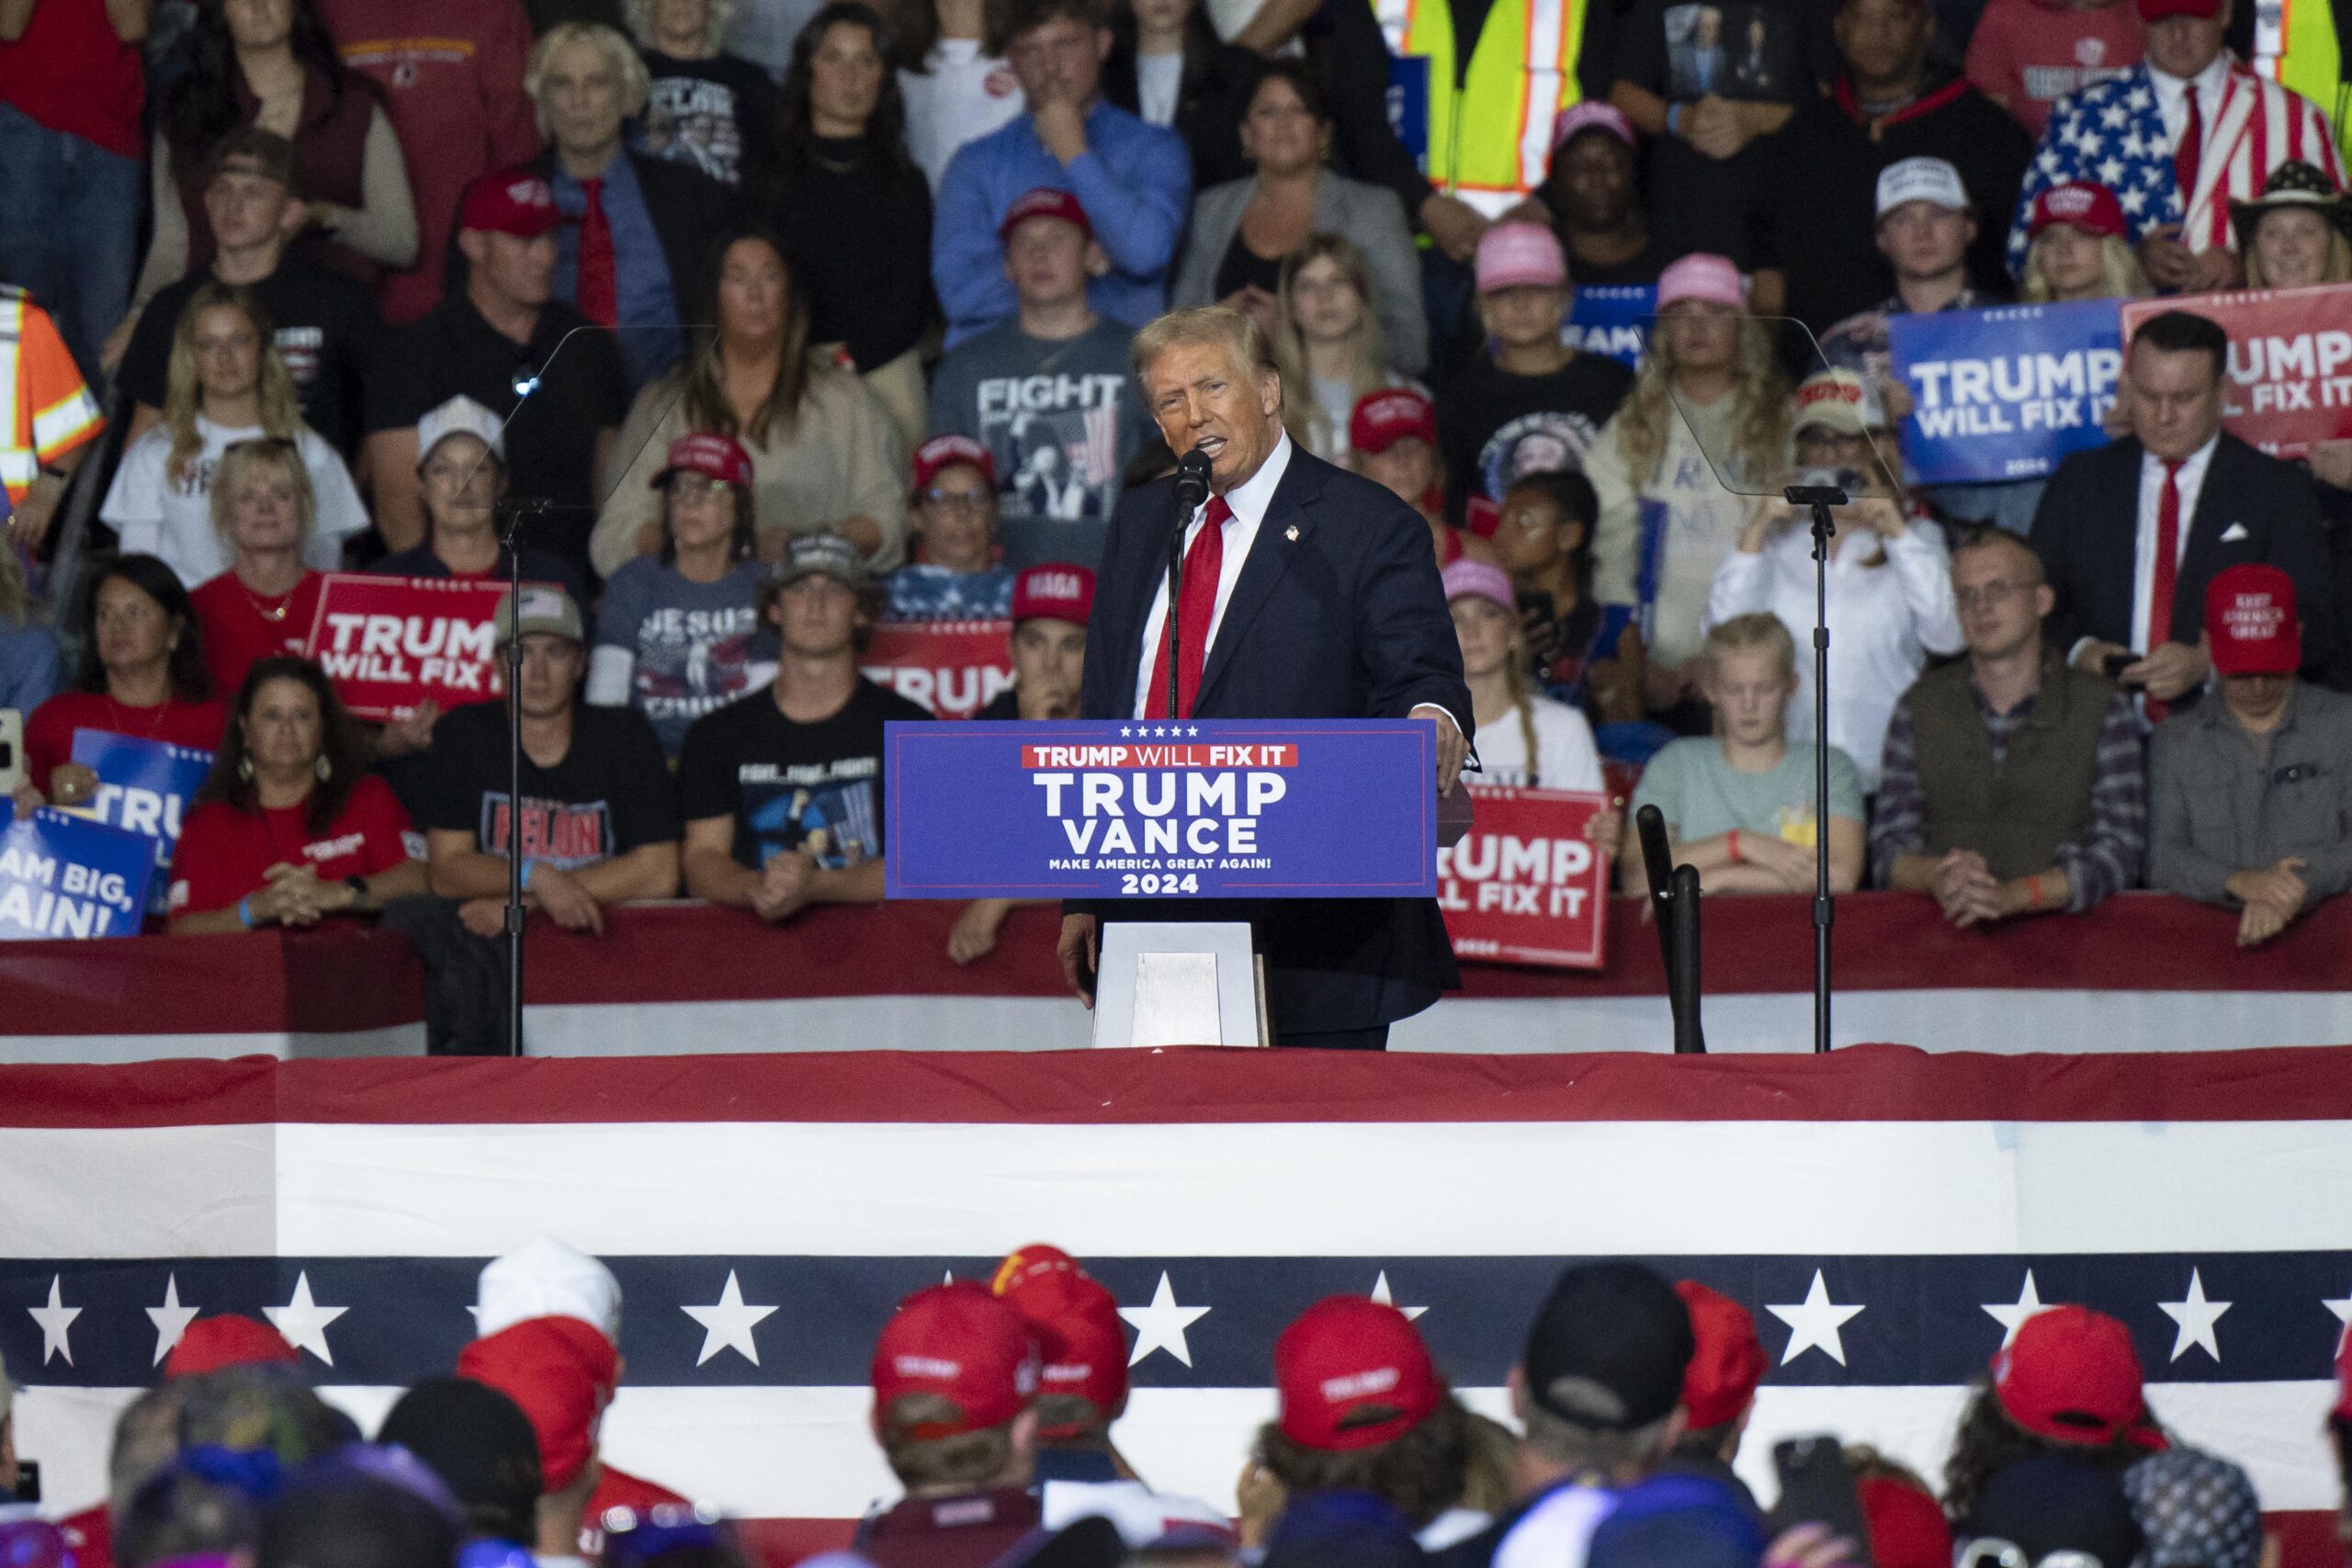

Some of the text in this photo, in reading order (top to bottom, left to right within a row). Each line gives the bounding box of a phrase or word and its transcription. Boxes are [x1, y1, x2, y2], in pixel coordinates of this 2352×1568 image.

[978, 375, 1125, 411] FIGHT
[1910, 349, 2122, 409] TRUMP
[2253, 379, 2312, 413] FIX
[1916, 404, 2013, 439] WILL
[2021, 399, 2082, 431] FIX
[326, 612, 495, 662] TRUM
[321, 649, 413, 683] WILL
[419, 656, 481, 692] FIX
[1034, 746, 1286, 766] TRUMP WILL FIX IT
[1034, 773, 1286, 817] TRUMP
[1062, 818, 1257, 854] VANCE
[1049, 859, 1272, 870] MAKE AMERICA GREAT AGAIN!
[62, 863, 133, 912] BIG,
[1121, 874, 1199, 895] 2024
[1477, 881, 1541, 916] FIX
[1549, 886, 1588, 919] IT
